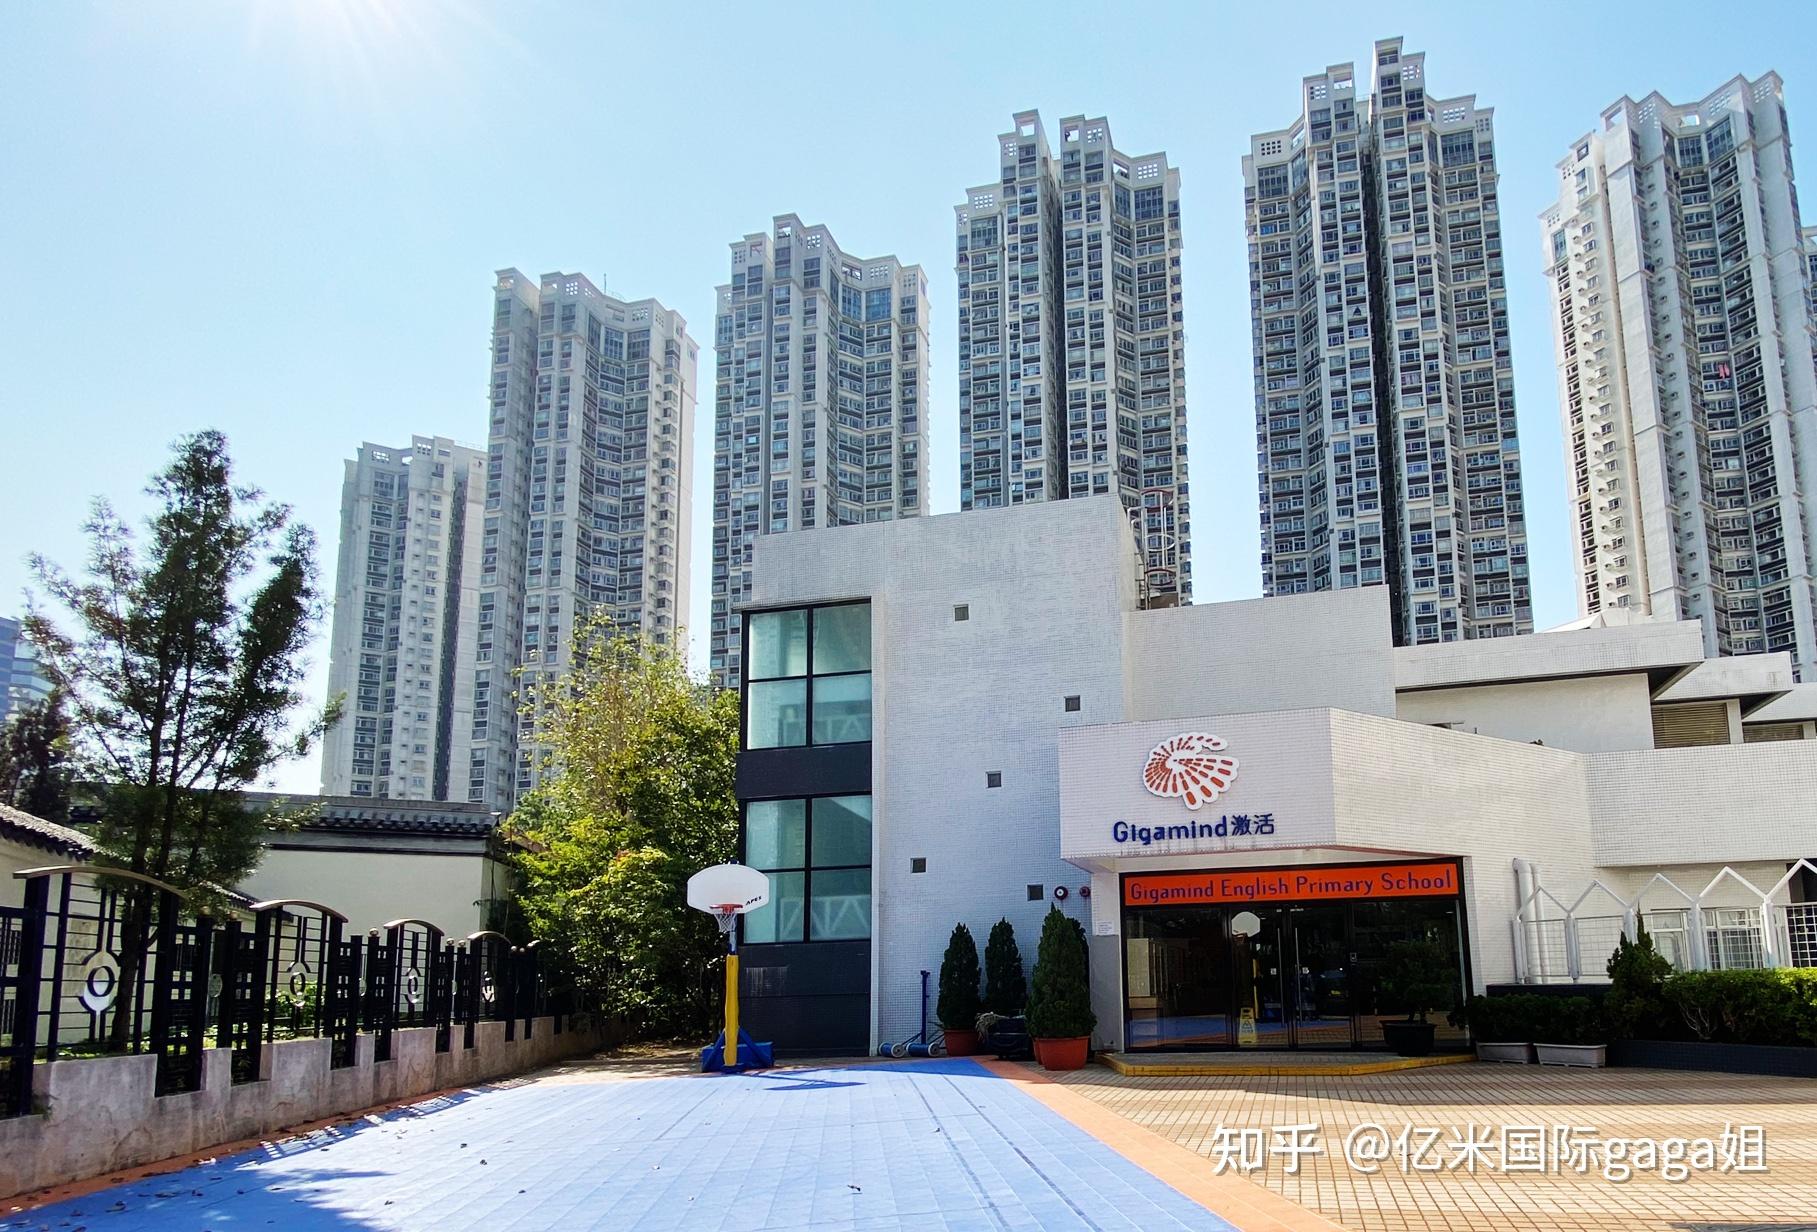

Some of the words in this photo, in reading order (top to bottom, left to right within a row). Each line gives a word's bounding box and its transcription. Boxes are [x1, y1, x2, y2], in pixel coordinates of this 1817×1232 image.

[1130, 880, 1214, 904] Gigamind
[1221, 877, 1289, 899] English
[1296, 876, 1374, 895] Primary
[1381, 869, 1451, 891] School
